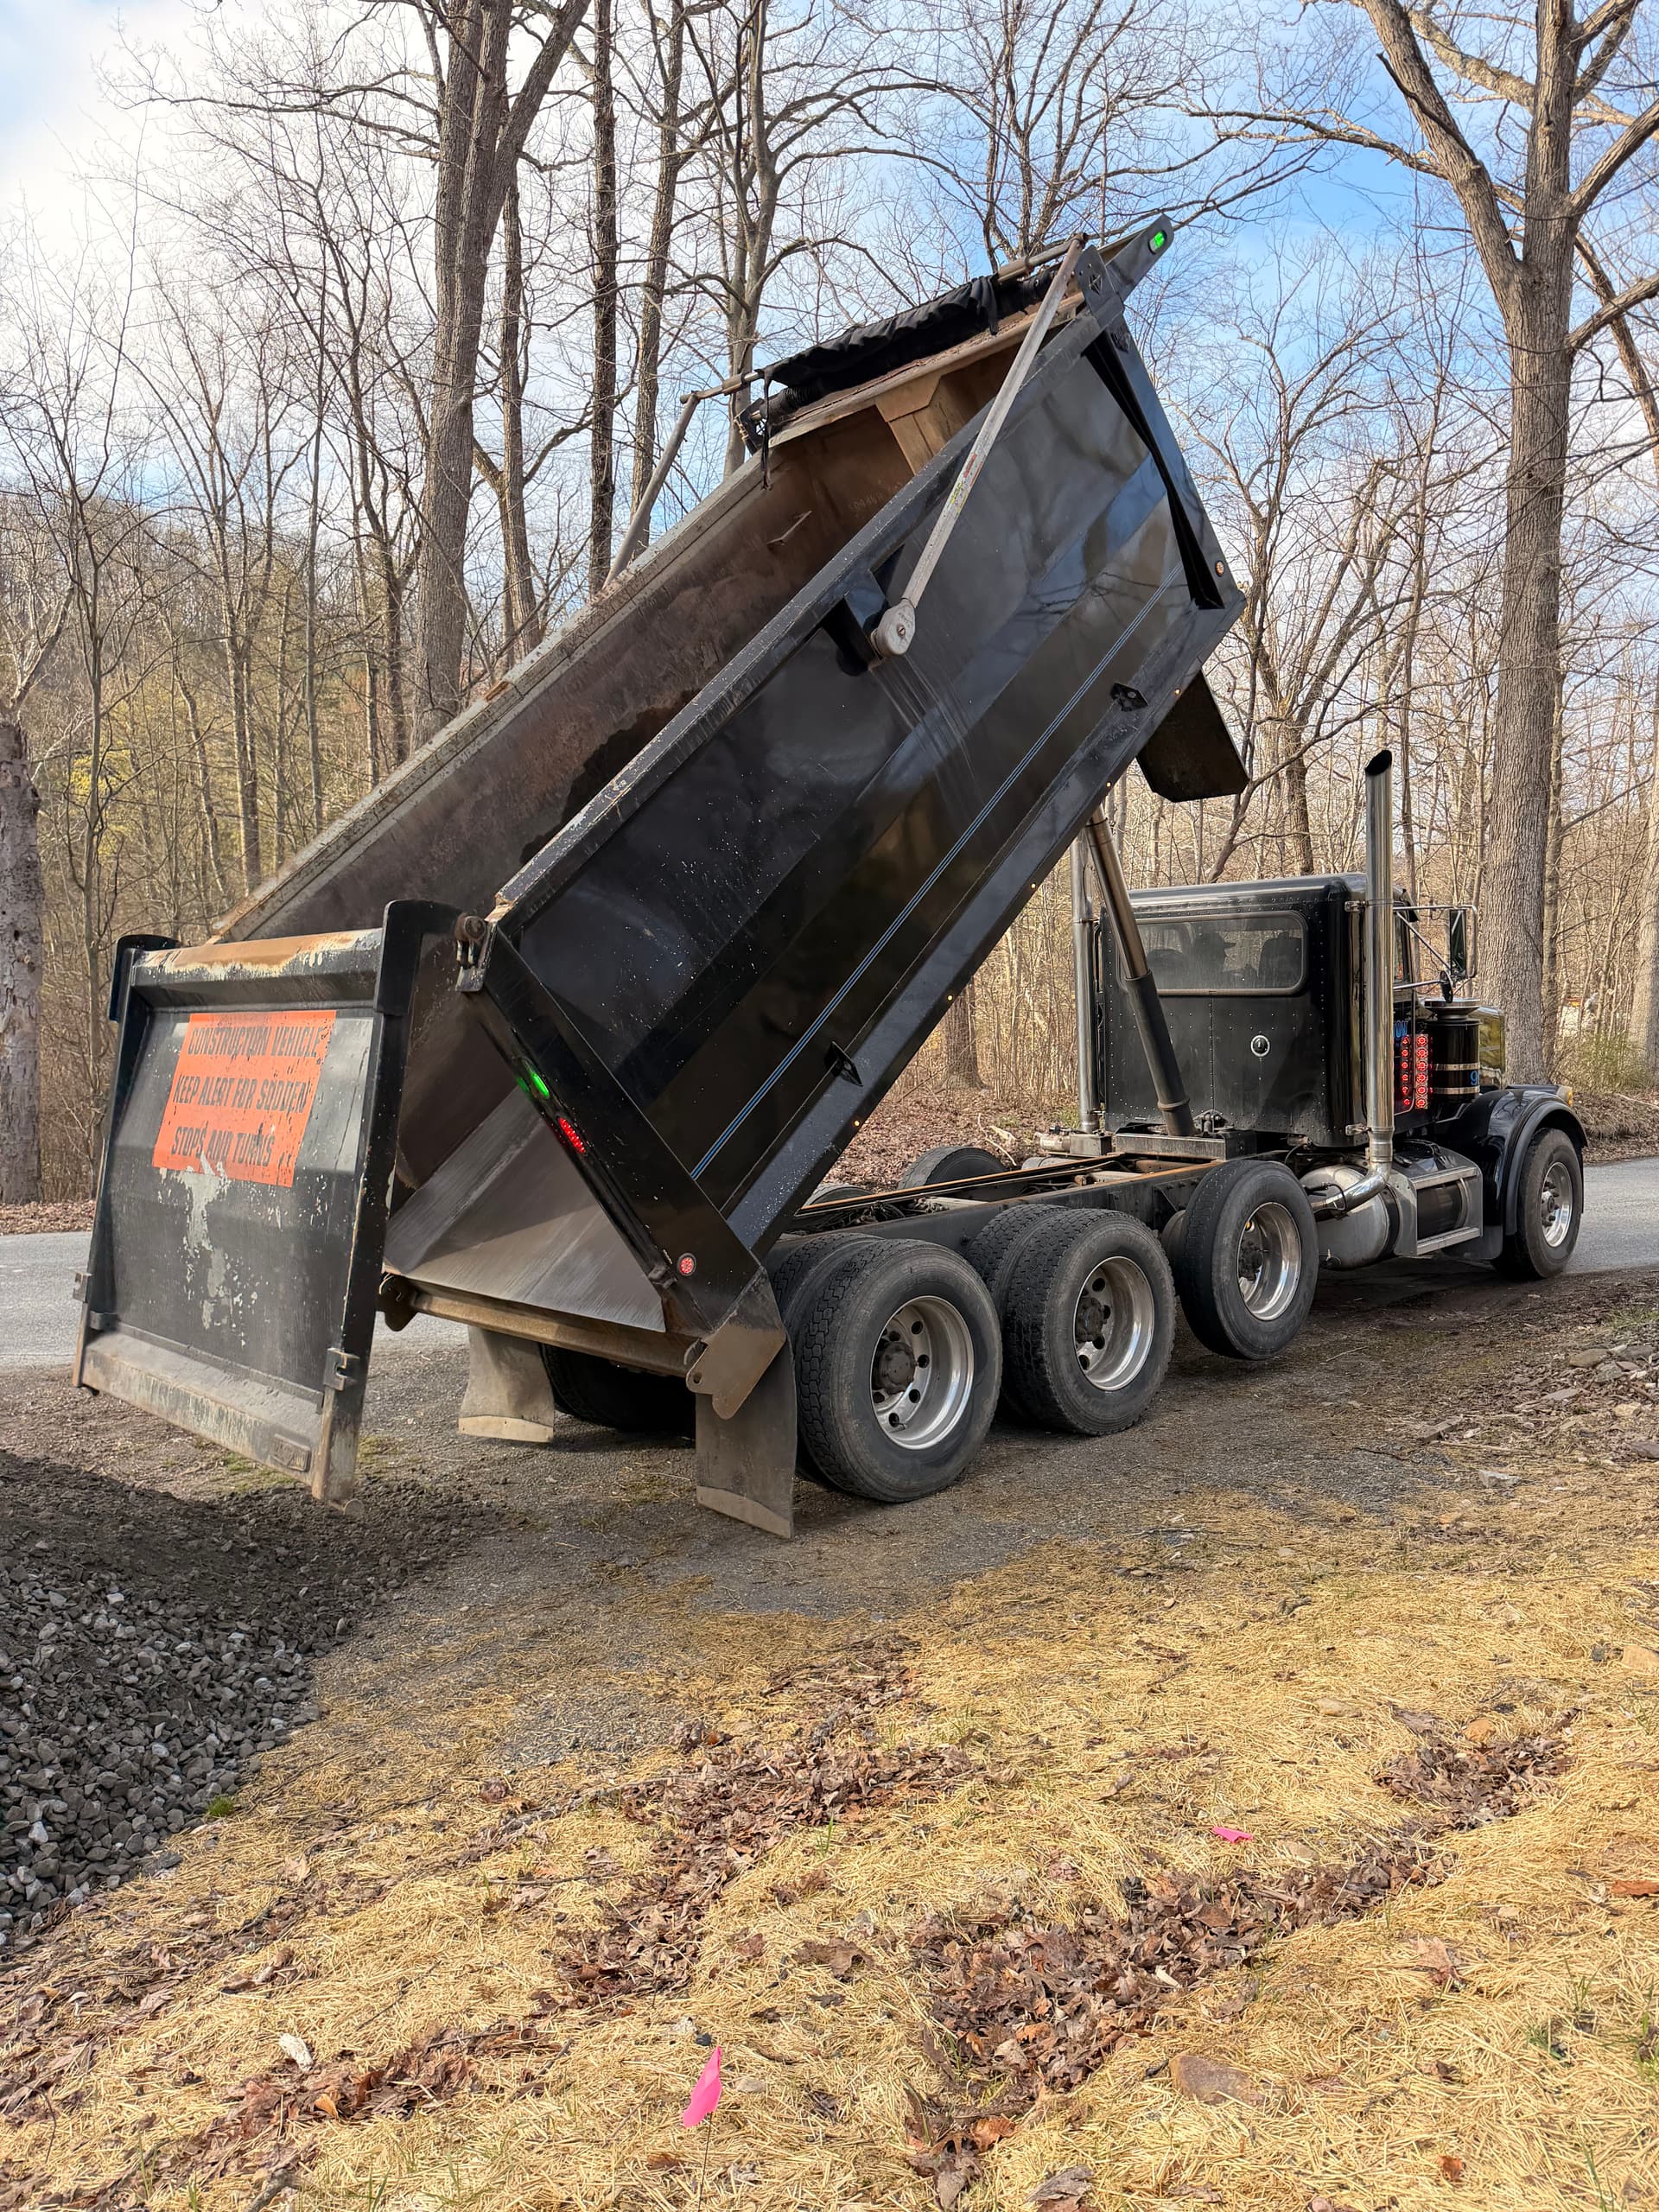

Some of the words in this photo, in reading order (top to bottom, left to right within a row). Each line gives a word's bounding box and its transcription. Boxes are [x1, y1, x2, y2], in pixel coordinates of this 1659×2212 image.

[188, 1027, 272, 1057] CONSTRUCTION
[270, 1026, 324, 1058] VEHICLE
[173, 1074, 200, 1103] KEEP
[198, 1076, 235, 1107] ALERT
[232, 1077, 257, 1109] FOR
[257, 1078, 309, 1114] SUDDEN
[171, 1126, 207, 1158] STOPS
[206, 1129, 233, 1162] AND
[232, 1132, 276, 1167] TURNS
